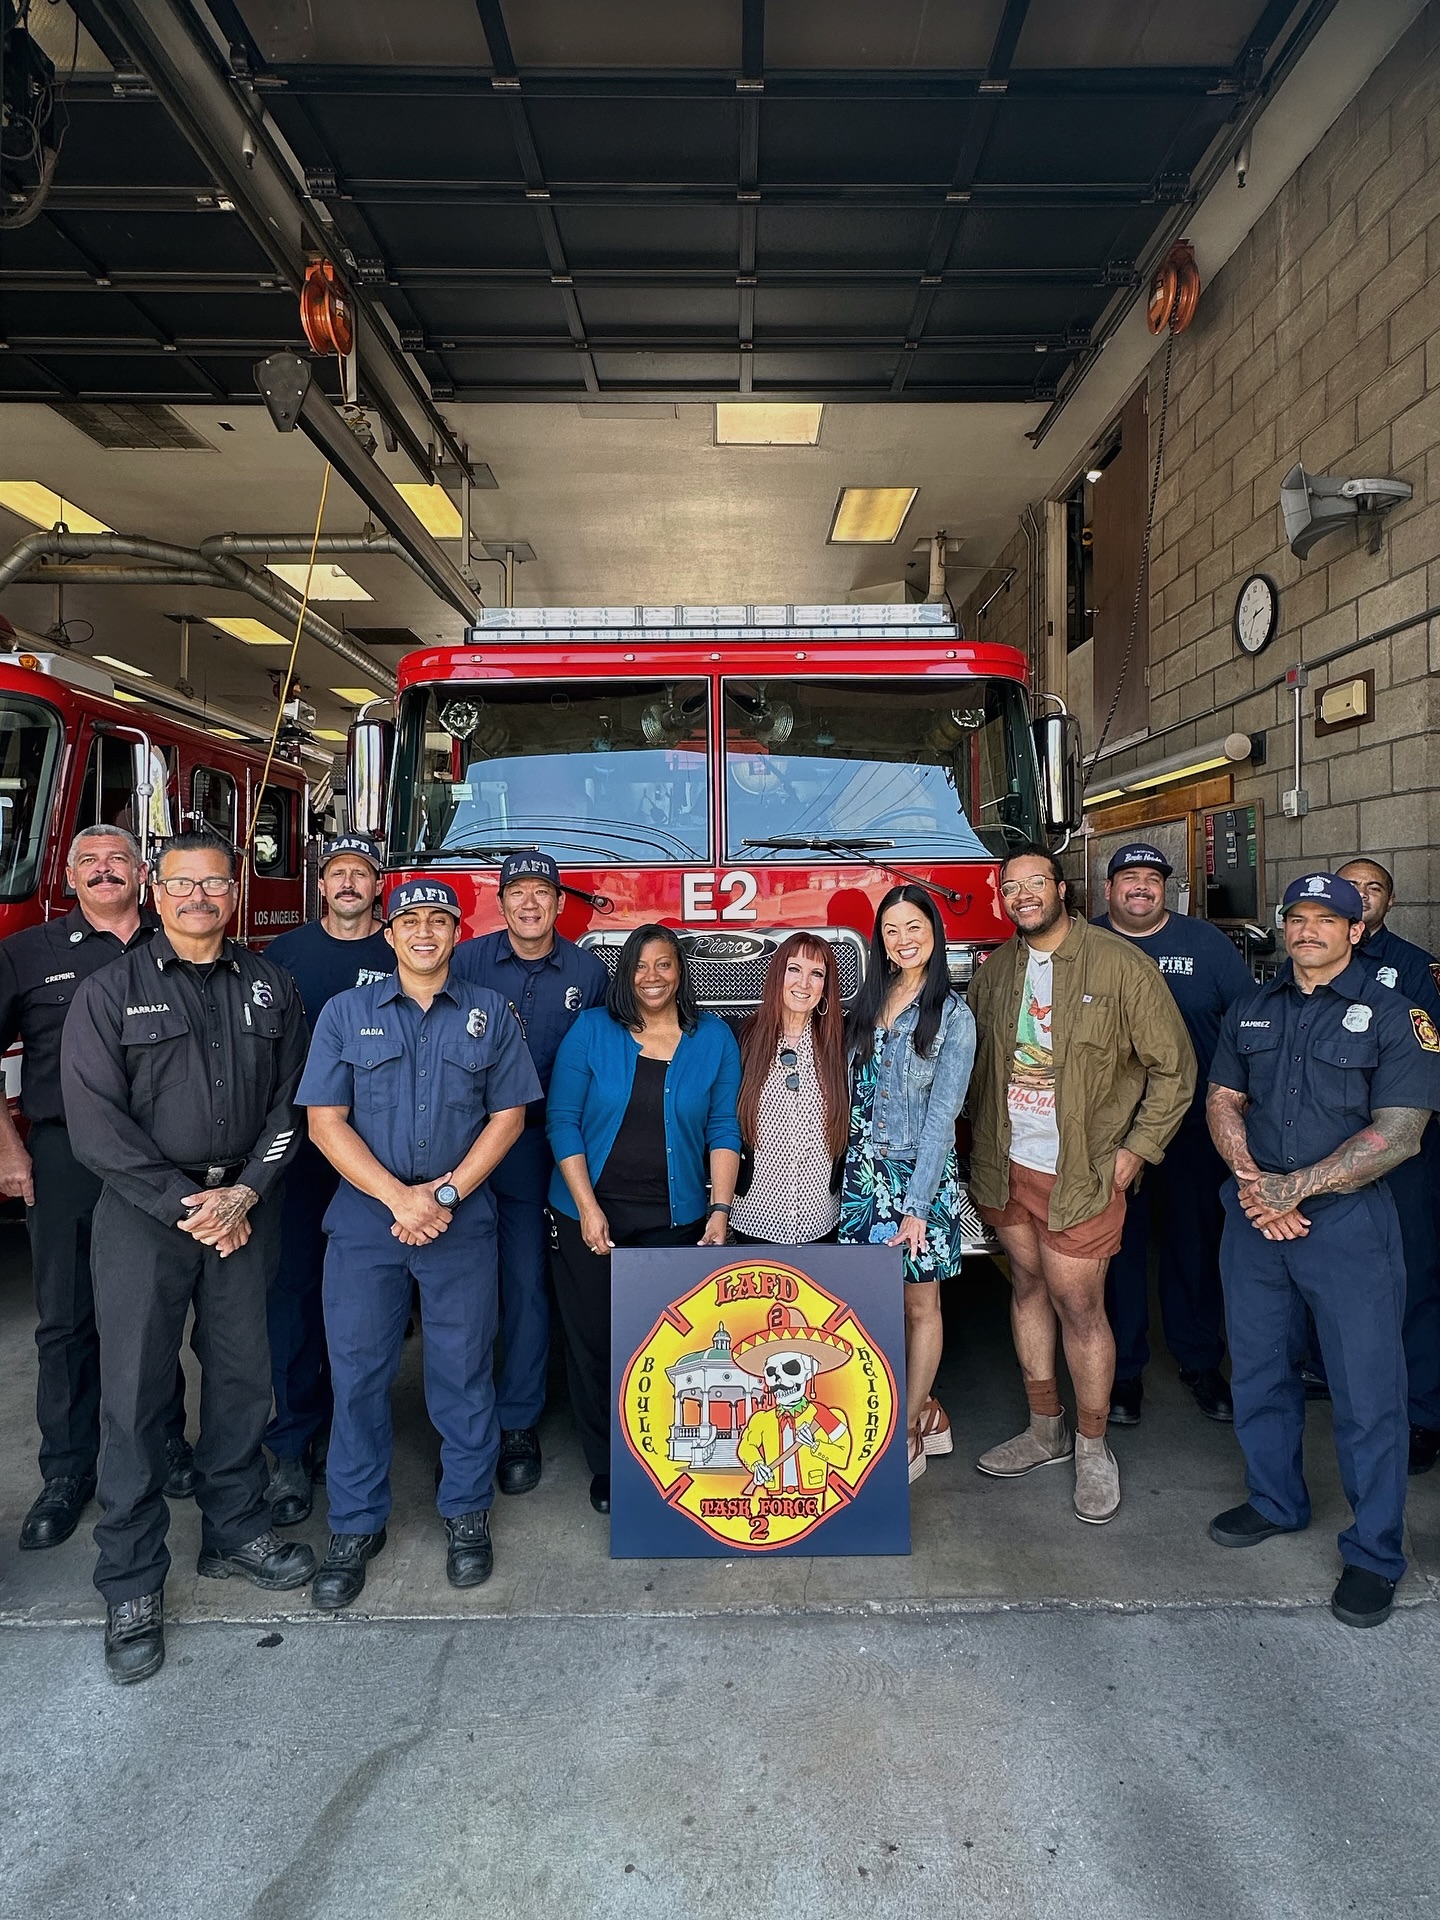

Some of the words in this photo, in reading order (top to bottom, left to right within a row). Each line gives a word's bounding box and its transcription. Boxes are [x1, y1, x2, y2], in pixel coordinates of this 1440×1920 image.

[330, 838, 371, 852] LAFD
[509, 859, 551, 875] LAFD
[400, 887, 449, 906] LAFD
[682, 870, 758, 922] E2
[254, 910, 269, 926] LOS
[270, 910, 300, 925] ANGELES
[690, 936, 753, 957] Pierce
[1158, 959, 1194, 972] FIRE
[126, 1003, 170, 1016] BARRAZA
[1240, 1020, 1271, 1028] RAMIREZ
[1030, 1106, 1051, 1116] Heat
[715, 1271, 799, 1307] LAFD
[771, 1307, 783, 1327] 2
[637, 1356, 657, 1456] BOYLE
[700, 1498, 752, 1520] TASK
[758, 1497, 820, 1519] FORCE
[749, 1515, 770, 1541] 2
